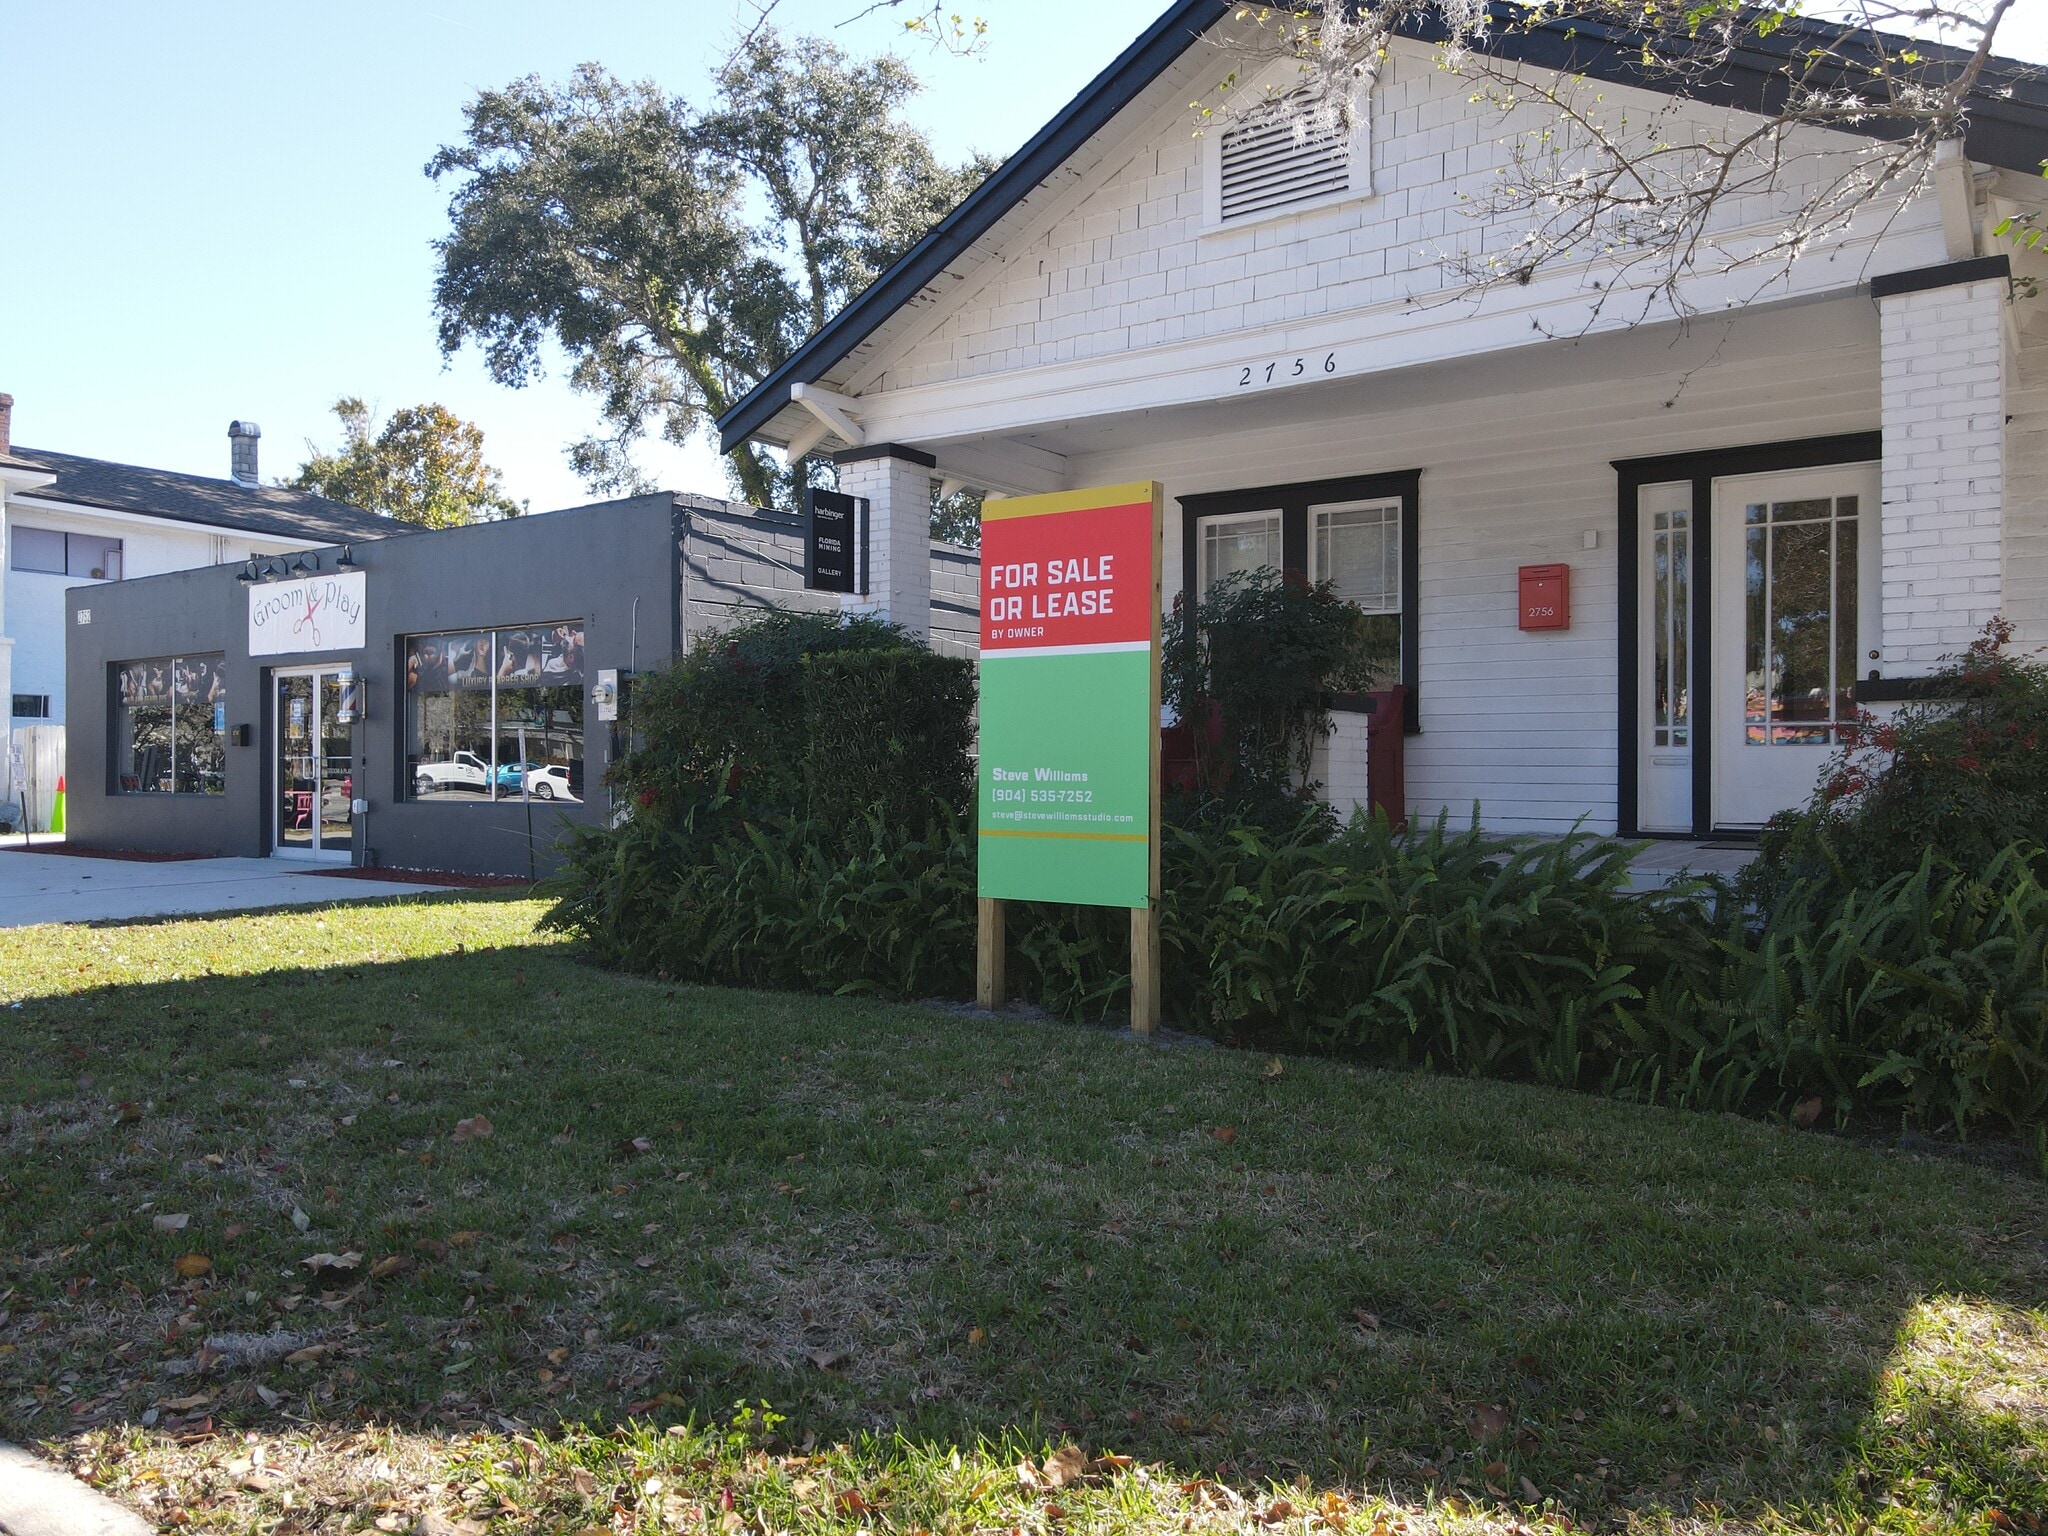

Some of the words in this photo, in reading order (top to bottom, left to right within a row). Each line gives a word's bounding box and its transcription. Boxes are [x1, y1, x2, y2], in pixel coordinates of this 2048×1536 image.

[1239, 352, 1335, 386] 2756
[815, 506, 844, 520] harbinger
[818, 537, 841, 546] FLORIDA
[818, 543, 841, 553] MINING
[817, 567, 841, 577] GALLERY
[990, 563, 1038, 590] FOR
[1047, 555, 1114, 585] SALE
[253, 588, 303, 627] Groom
[323, 581, 361, 625] Play
[990, 596, 1022, 621] OR
[1032, 588, 1114, 619] LEASE
[1528, 607, 1554, 617] 2756
[991, 629, 1003, 639] BY
[1007, 626, 1044, 638] OWNER
[993, 767, 1029, 781] Steve
[1034, 768, 1088, 782] Williams
[992, 788, 1026, 803] (904)
[1031, 790, 1092, 803] 535-7252
[992, 811, 1133, 823] steve@stevewilliamsstudio.com
